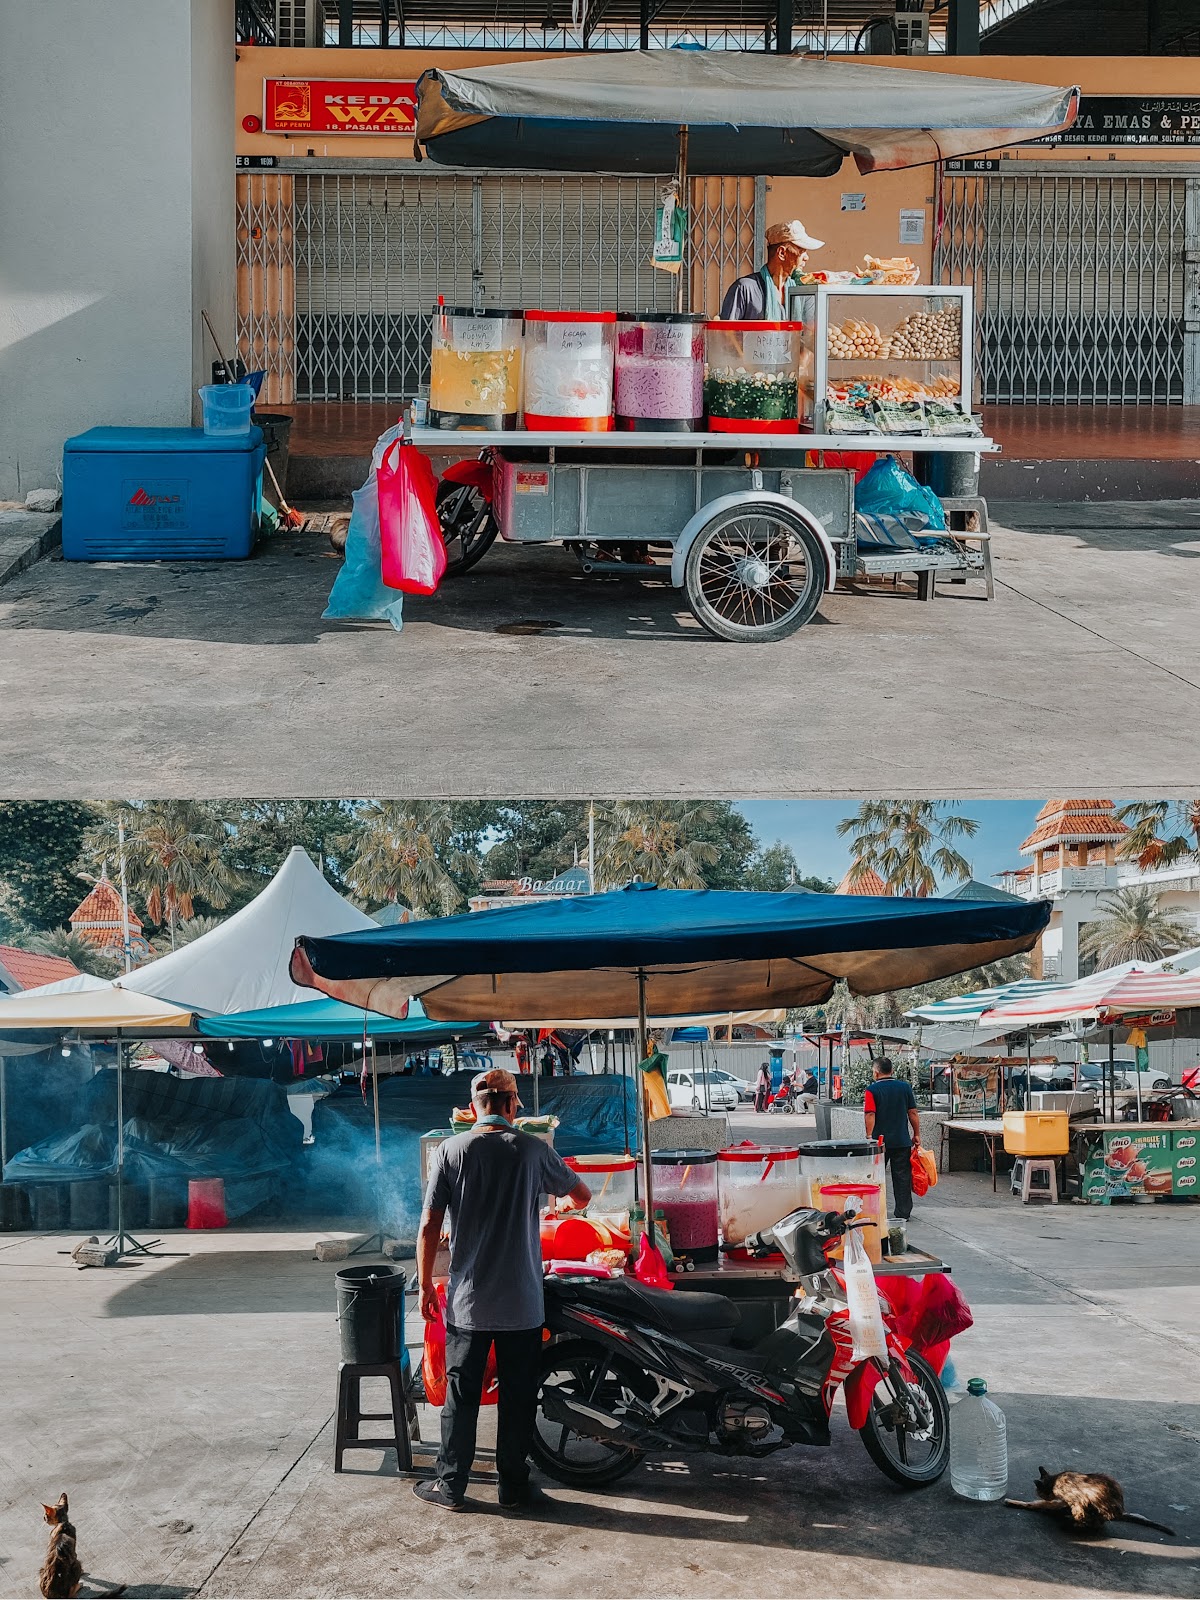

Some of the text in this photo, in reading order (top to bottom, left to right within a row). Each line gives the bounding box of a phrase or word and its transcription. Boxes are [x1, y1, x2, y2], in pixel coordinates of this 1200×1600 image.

[325, 105, 412, 123] WA
[1103, 115, 1151, 129] EMAS
[1160, 114, 1172, 129] &
[1087, 134, 1108, 143] KEDAI
[1161, 135, 1185, 143] SULTAN
[243, 157, 250, 166] 8
[973, 160, 993, 170] KE 9
[561, 339, 583, 350] RM 3
[518, 876, 586, 892] Bazaar
[1152, 1012, 1172, 1022] MILO
[1111, 1138, 1130, 1147] MILO
